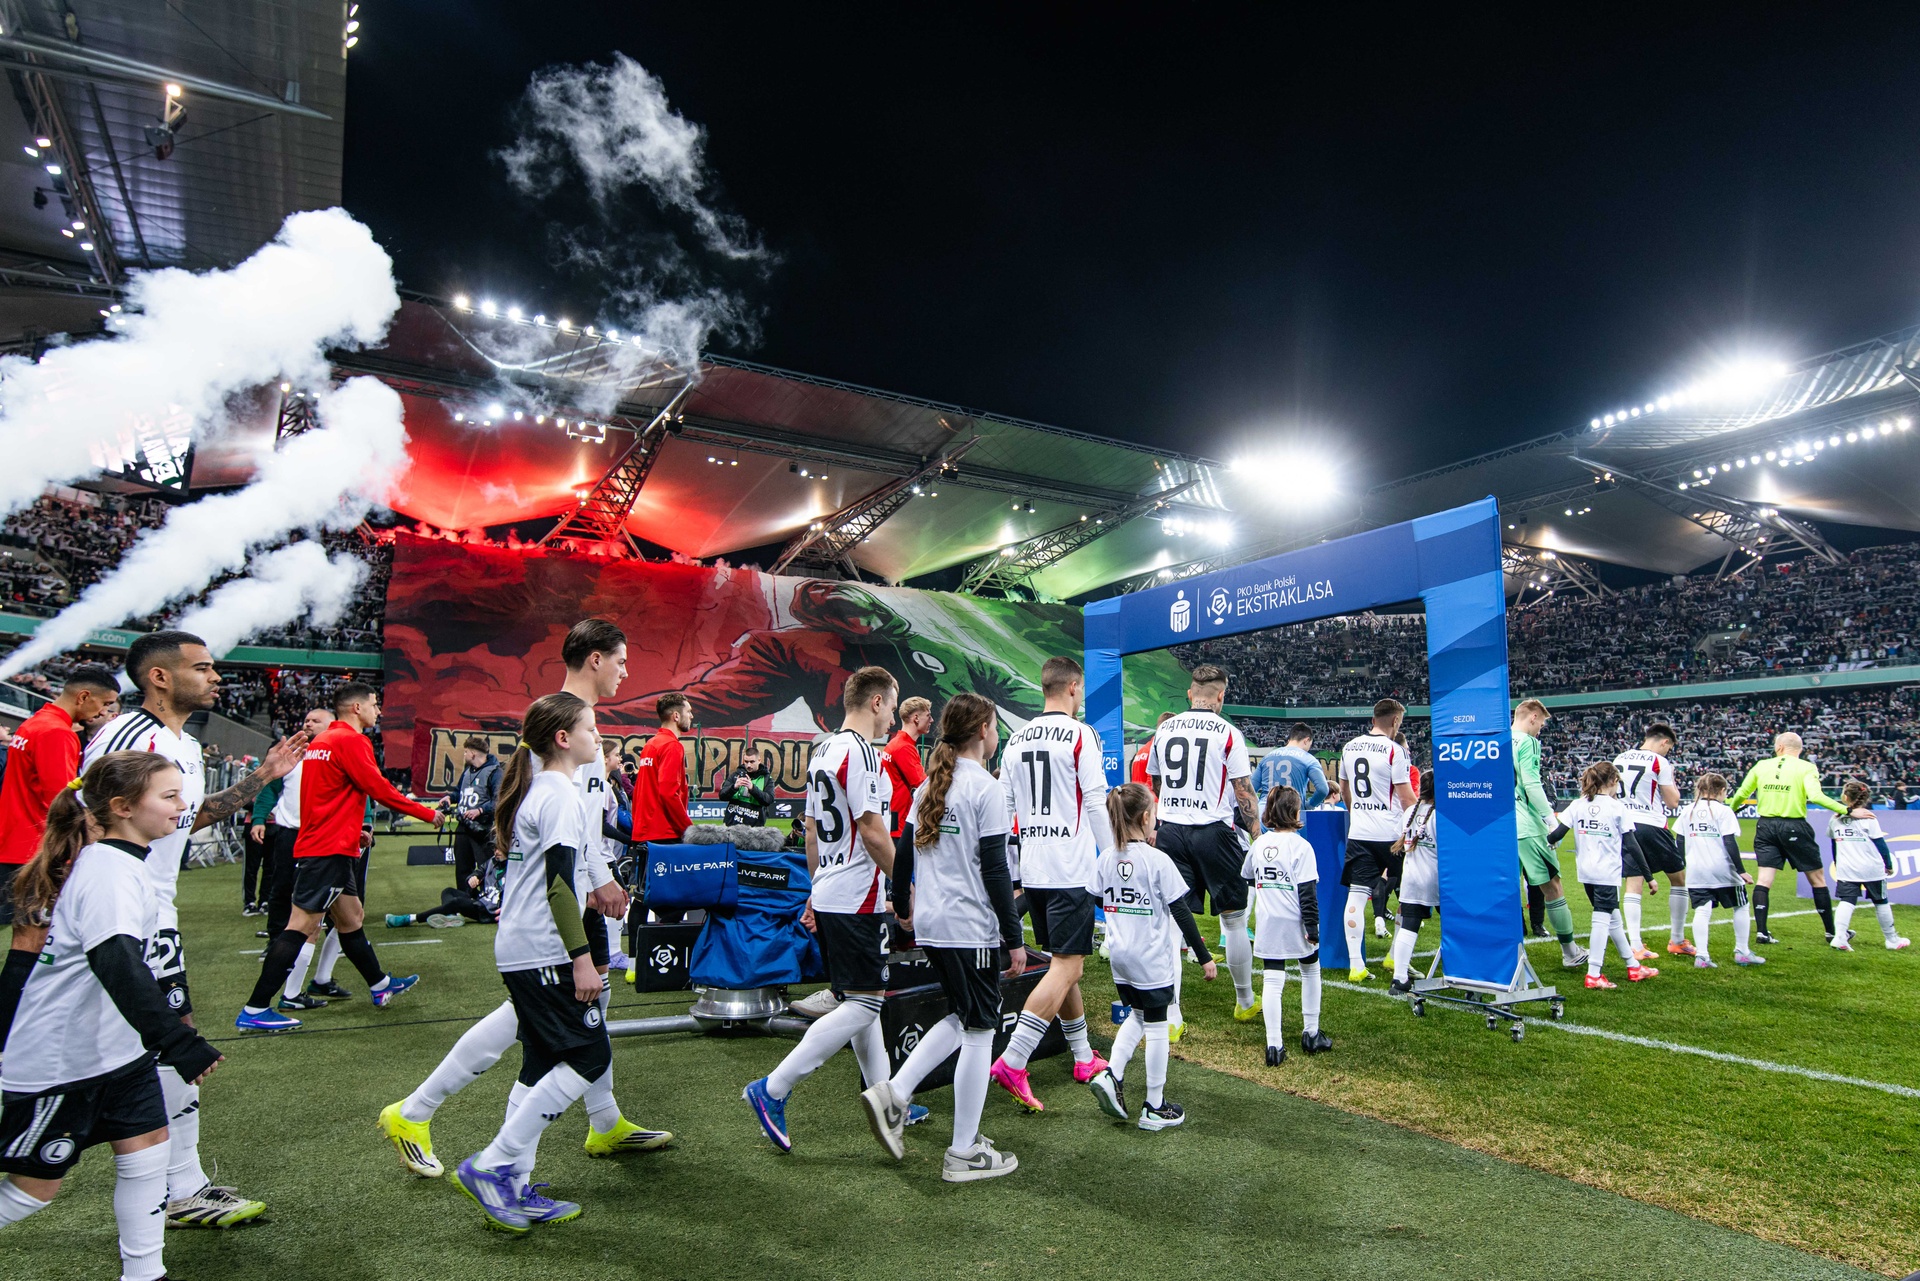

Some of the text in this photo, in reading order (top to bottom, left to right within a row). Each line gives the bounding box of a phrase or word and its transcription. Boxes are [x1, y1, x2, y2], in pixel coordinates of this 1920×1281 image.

[1237, 574, 1296, 598] PKO Bank Polski
[1237, 579, 1334, 617] EKSTRAKLASA
[1161, 718, 1226, 734] PIĄTKOWSKI
[1453, 715, 1475, 723] SEZON
[1009, 725, 1074, 746] CHODYNA
[1438, 740, 1500, 761] 25/26
[1165, 736, 1209, 791] 91
[1021, 750, 1051, 816] 11
[1266, 760, 1292, 789] 13
[1354, 757, 1372, 798] 8
[1448, 781, 1493, 790] Spotkajmy się
[1448, 791, 1493, 799] #NaStadionie
[1577, 819, 1609, 831] 1.5%
[1689, 823, 1717, 832] 1.5%
[674, 861, 734, 872] LIVE PARK
[1255, 867, 1291, 882] 1.5%
[758, 872, 786, 881] PARK
[322, 887, 344, 910] 17
[1104, 887, 1150, 905] 1.5%
